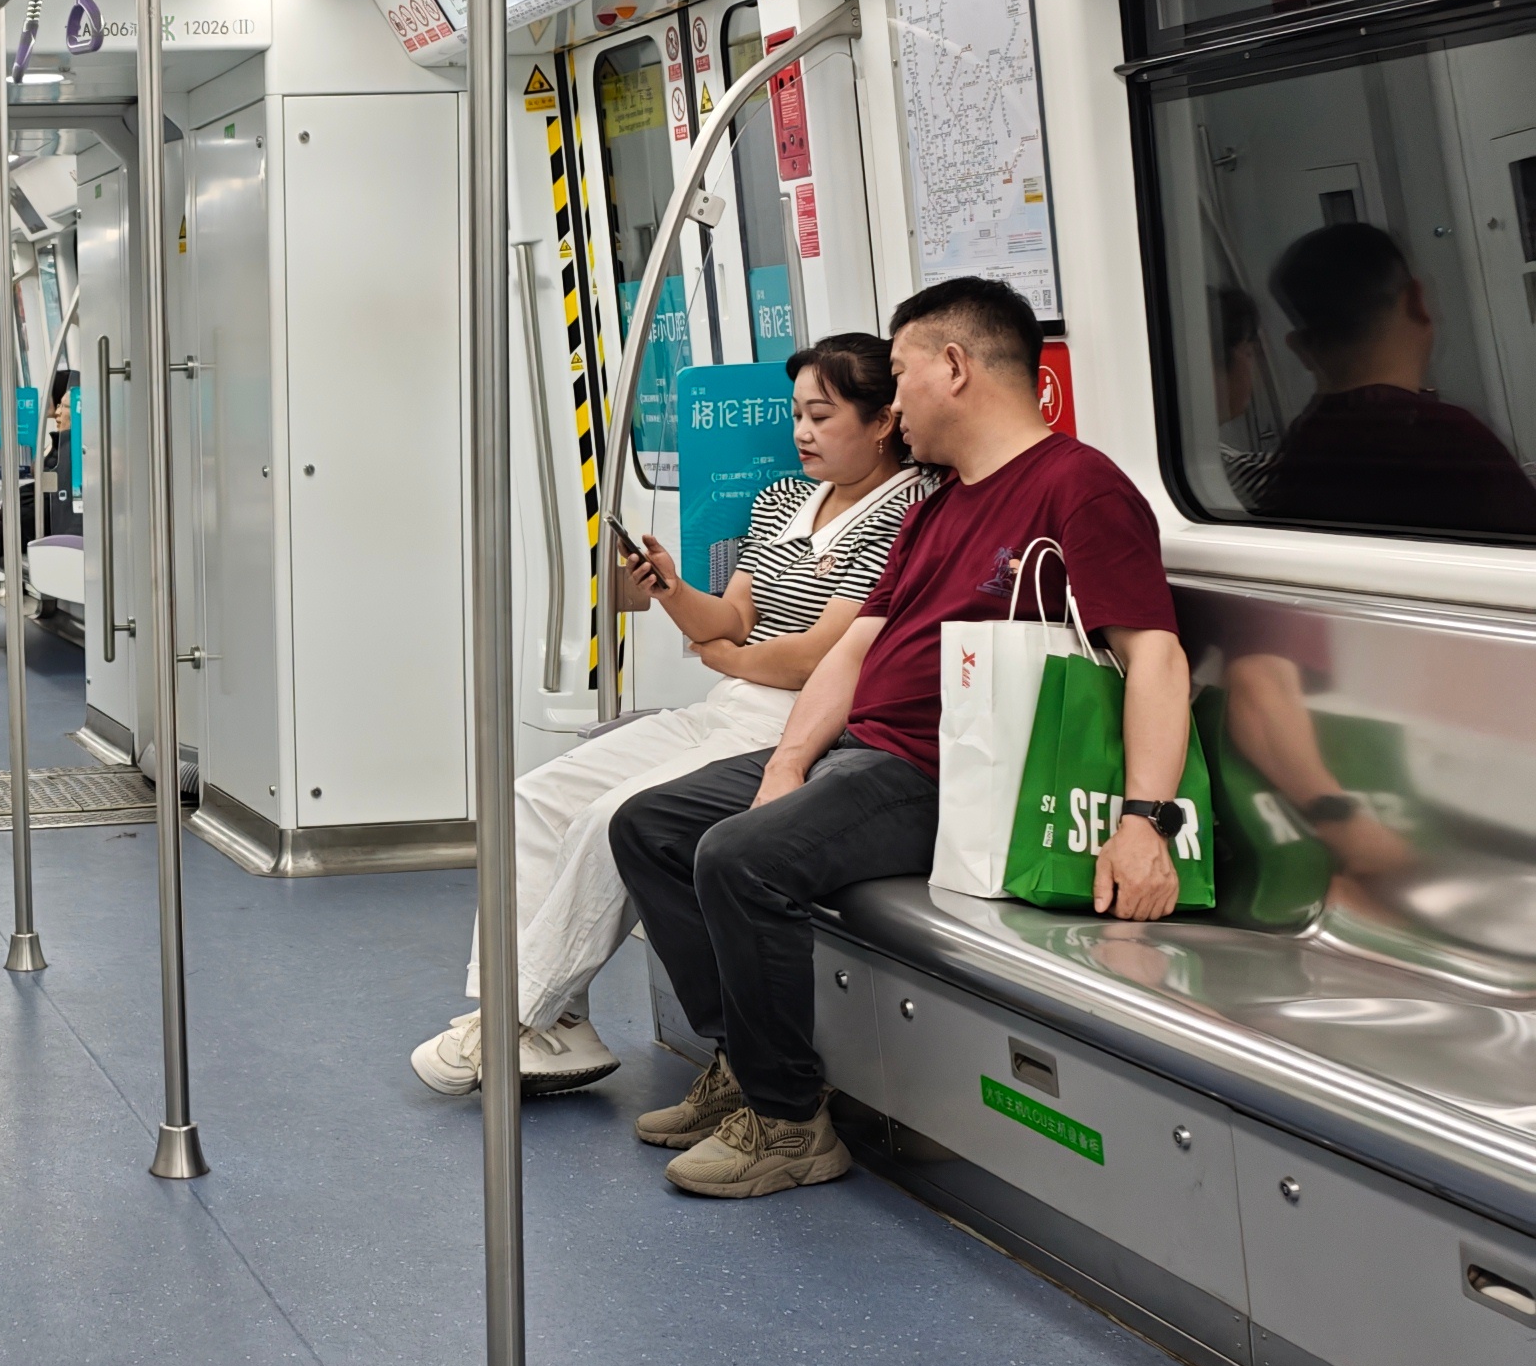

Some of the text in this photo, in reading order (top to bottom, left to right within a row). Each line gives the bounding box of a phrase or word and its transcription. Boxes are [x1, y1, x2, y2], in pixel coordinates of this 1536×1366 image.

[691, 396, 796, 431] 格伦菲尔
[1067, 787, 1202, 861] SER
